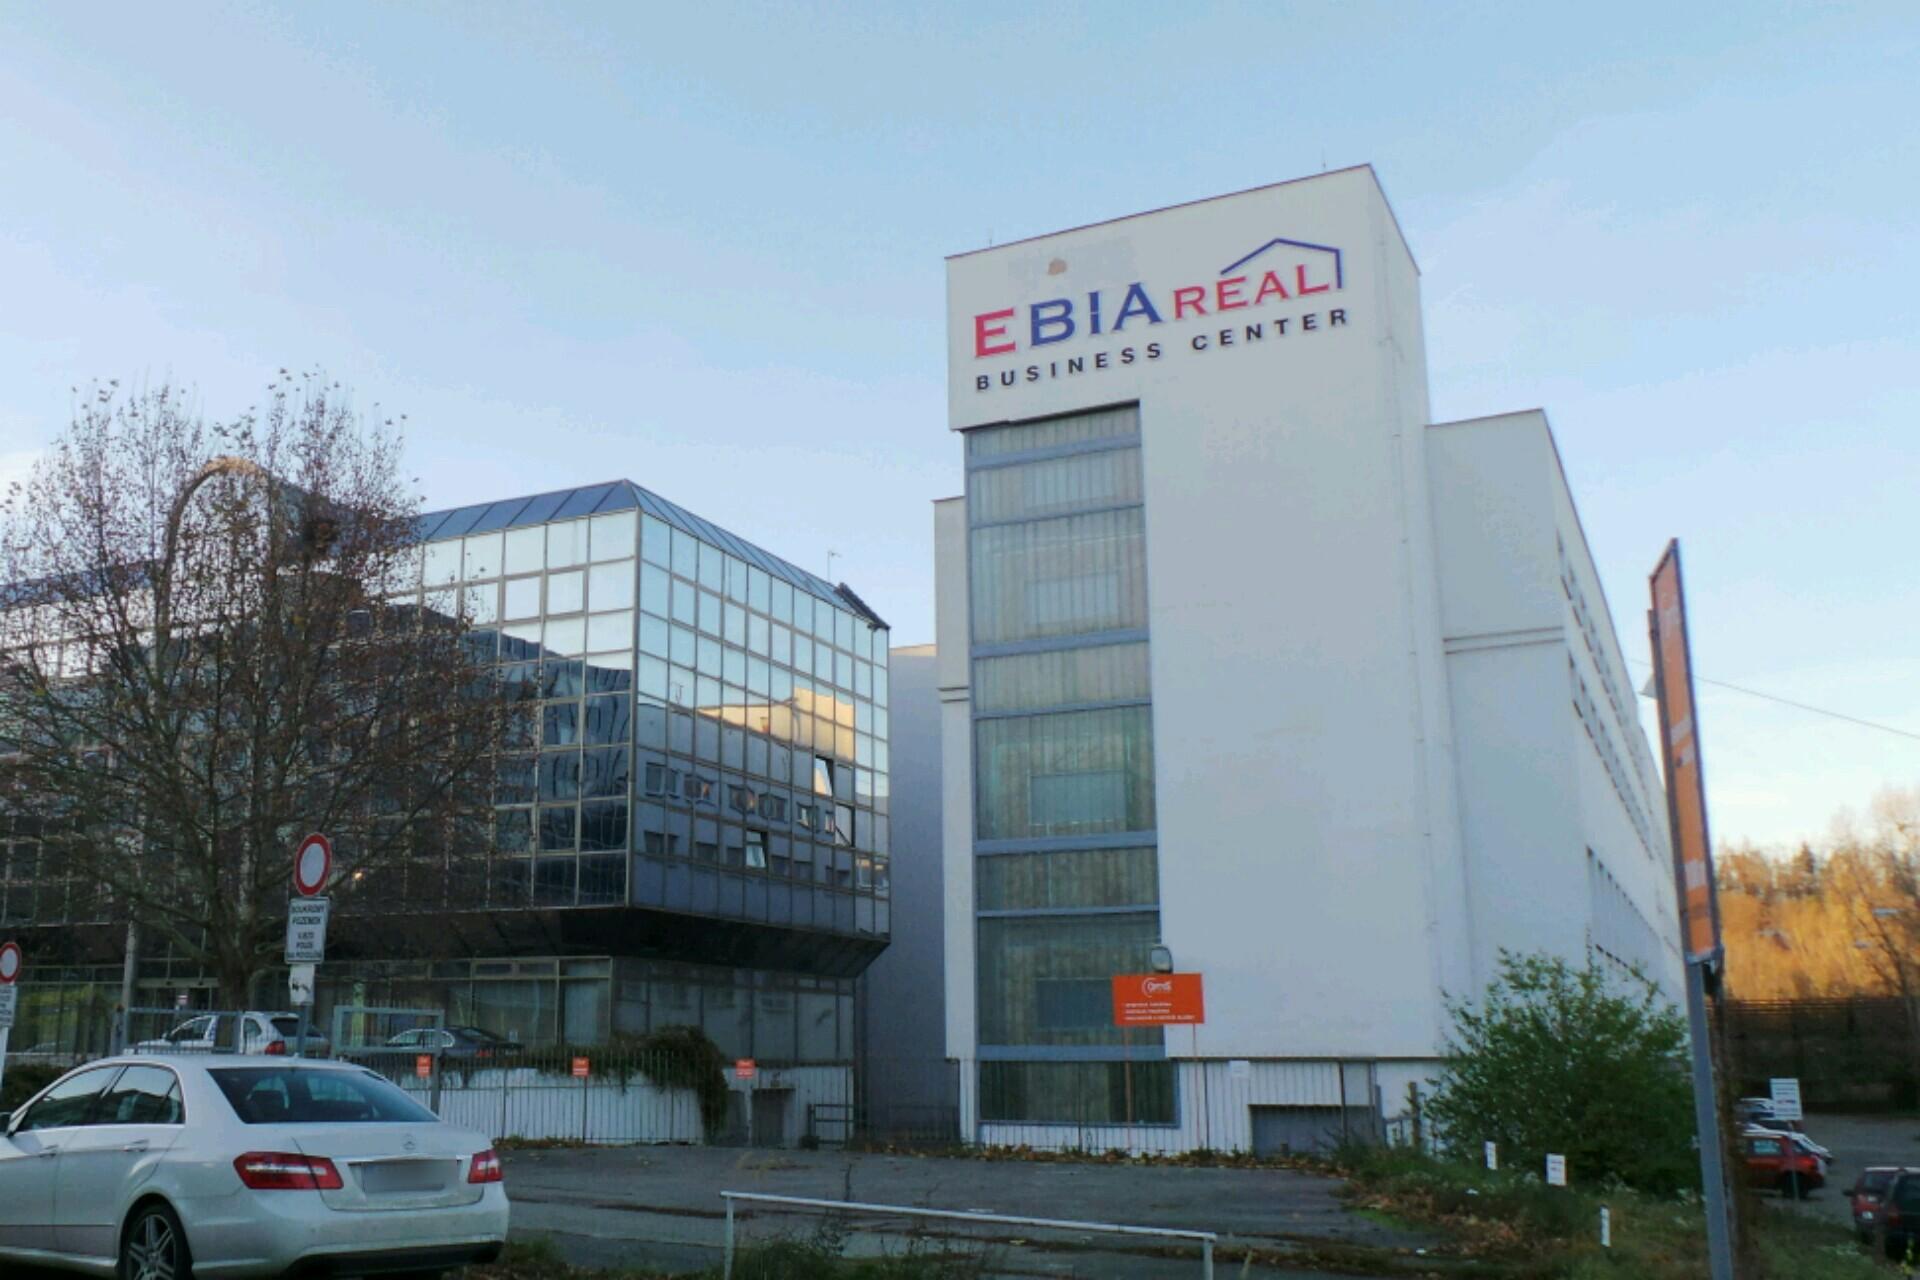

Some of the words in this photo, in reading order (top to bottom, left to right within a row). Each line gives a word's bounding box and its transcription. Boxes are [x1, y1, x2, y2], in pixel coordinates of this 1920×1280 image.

[1173, 264, 1330, 320] REAL
[976, 343, 1161, 391] BUSINESS
[1191, 308, 1347, 351] CENTER
